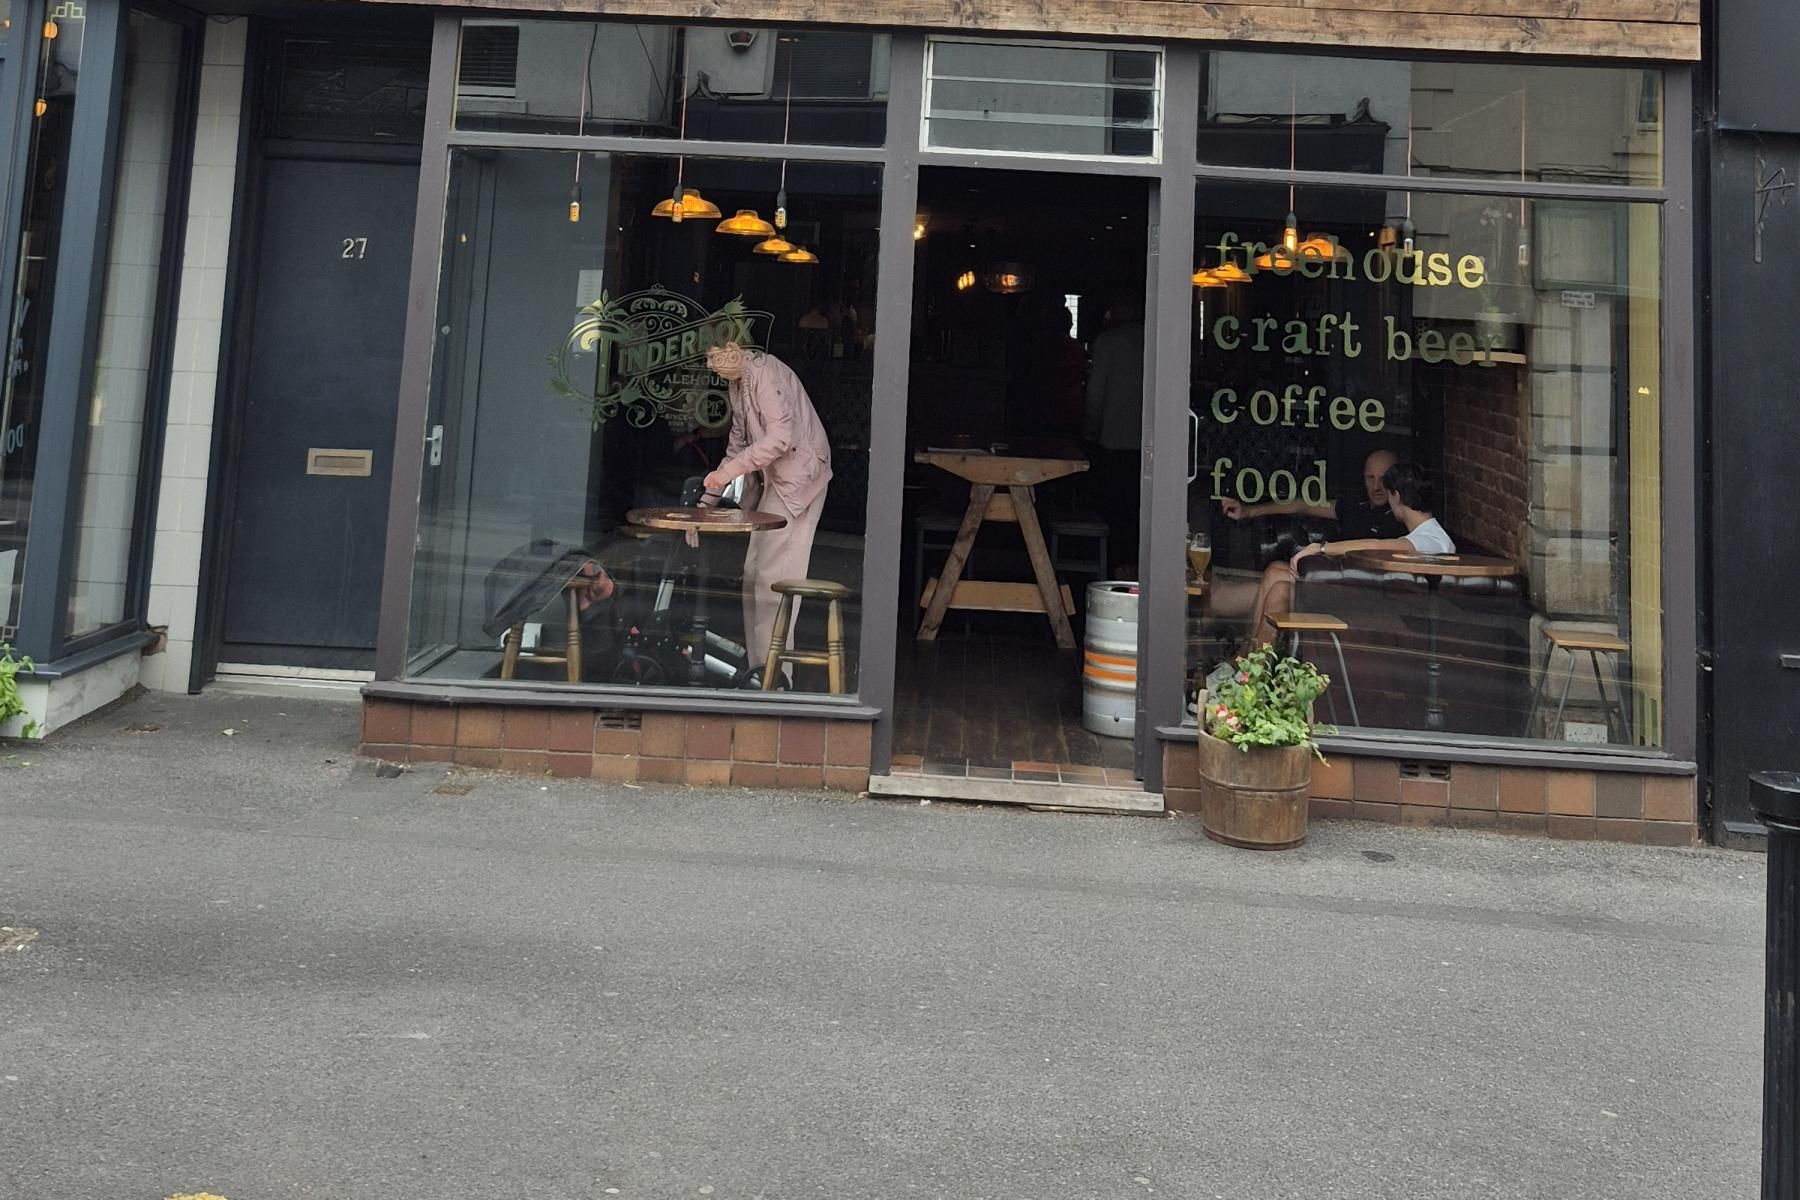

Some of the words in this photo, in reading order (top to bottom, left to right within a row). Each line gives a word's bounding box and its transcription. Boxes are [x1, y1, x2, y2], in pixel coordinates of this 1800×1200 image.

[342, 237, 368, 259] 27
[1218, 231, 1485, 288] freehouse
[1212, 311, 1362, 358] craft
[1384, 315, 1504, 368] beer
[1211, 384, 1386, 433] coffee
[1210, 457, 1332, 508] food
